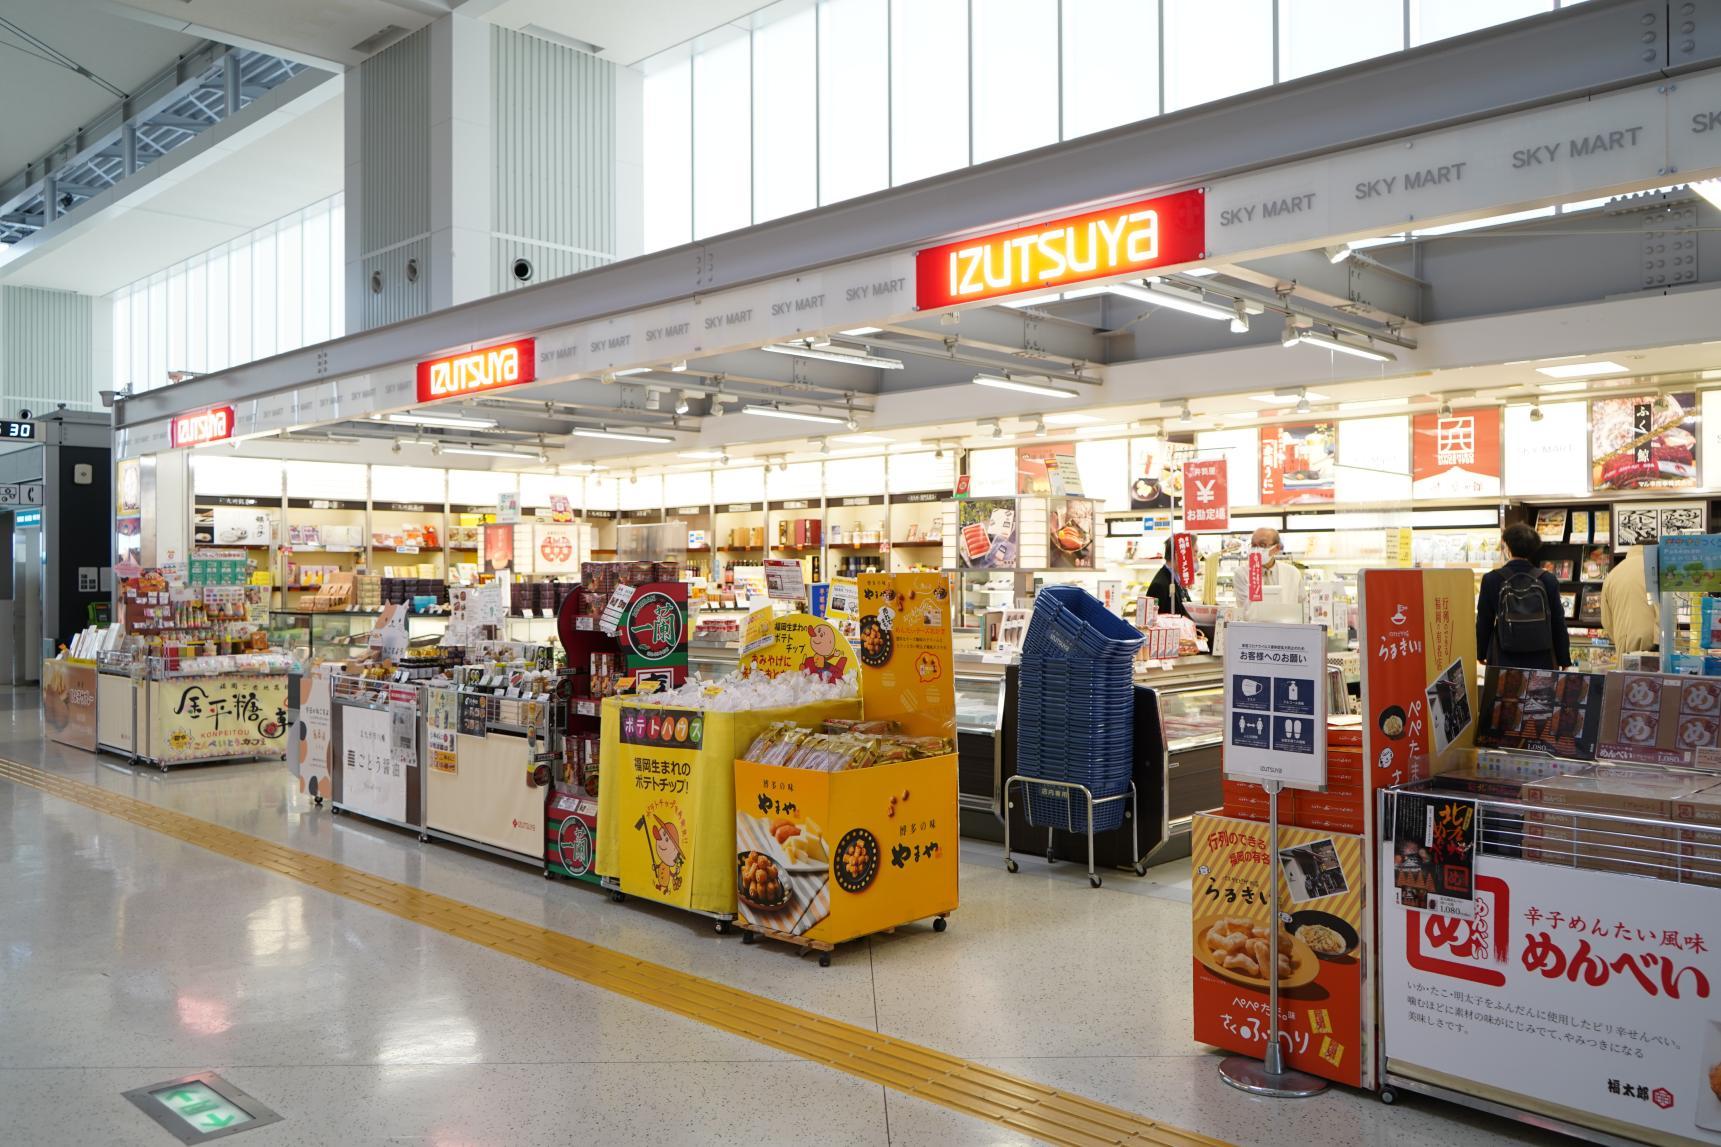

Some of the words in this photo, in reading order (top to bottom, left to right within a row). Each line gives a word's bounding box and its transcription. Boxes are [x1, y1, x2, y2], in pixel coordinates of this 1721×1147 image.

[1512, 143, 1561, 169] SKY
[1569, 127, 1643, 158] MART
[1355, 176, 1394, 200] SKY
[1404, 163, 1467, 191] MART
[1220, 207, 1255, 227] SKY
[1262, 193, 1316, 218] MART
[846, 287, 870, 302] SKY
[872, 278, 905, 297] MART
[771, 302, 793, 316] SKY
[795, 294, 825, 312] MART
[704, 316, 724, 330] SKY
[726, 309, 753, 327] MART
[645, 328, 663, 342] SKY
[665, 322, 690, 338] MART
[590, 340, 607, 353] SKY
[608, 335, 631, 349] MART
[9, 423, 31, 438] 30
[1187, 507, 1226, 521] お勘定場
[631, 603, 677, 647] 一蘭
[775, 622, 807, 632] 福岡生まれの
[775, 633, 793, 643] ポテト
[786, 643, 806, 653] チップ
[1239, 651, 1307, 664] お客様へのお願い
[200, 729, 250, 738] KONPEITOU
[624, 716, 703, 740] ポテトハウス
[634, 757, 691, 777] 福岡生まれの
[635, 776, 690, 794] ポテトチップ!
[763, 779, 794, 792] 博多の味
[758, 793, 797, 815] やまや
[900, 818, 937, 837] 博多の味
[1207, 830, 1267, 853] 行列のできる
[891, 841, 939, 869] やまや
[1229, 850, 1271, 868] 福岡の有名
[1440, 906, 1461, 915] 1,080
[1472, 896, 1490, 960] めんべい
[1524, 906, 1709, 954] 辛子めんたい風味
[1521, 931, 1711, 1000] めんべい
[1232, 997, 1297, 1020] ぺぺた。味
[1407, 981, 1681, 1051] いか・たこ・明太子をふんだんに使用したピリ辛せんべい。
[1407, 995, 1644, 1059] 噛むほどに素材の味がにじみでて、やみつきになる
[1408, 1010, 1469, 1035] 美味しさです。
[1607, 1078, 1650, 1102] 福太郎
